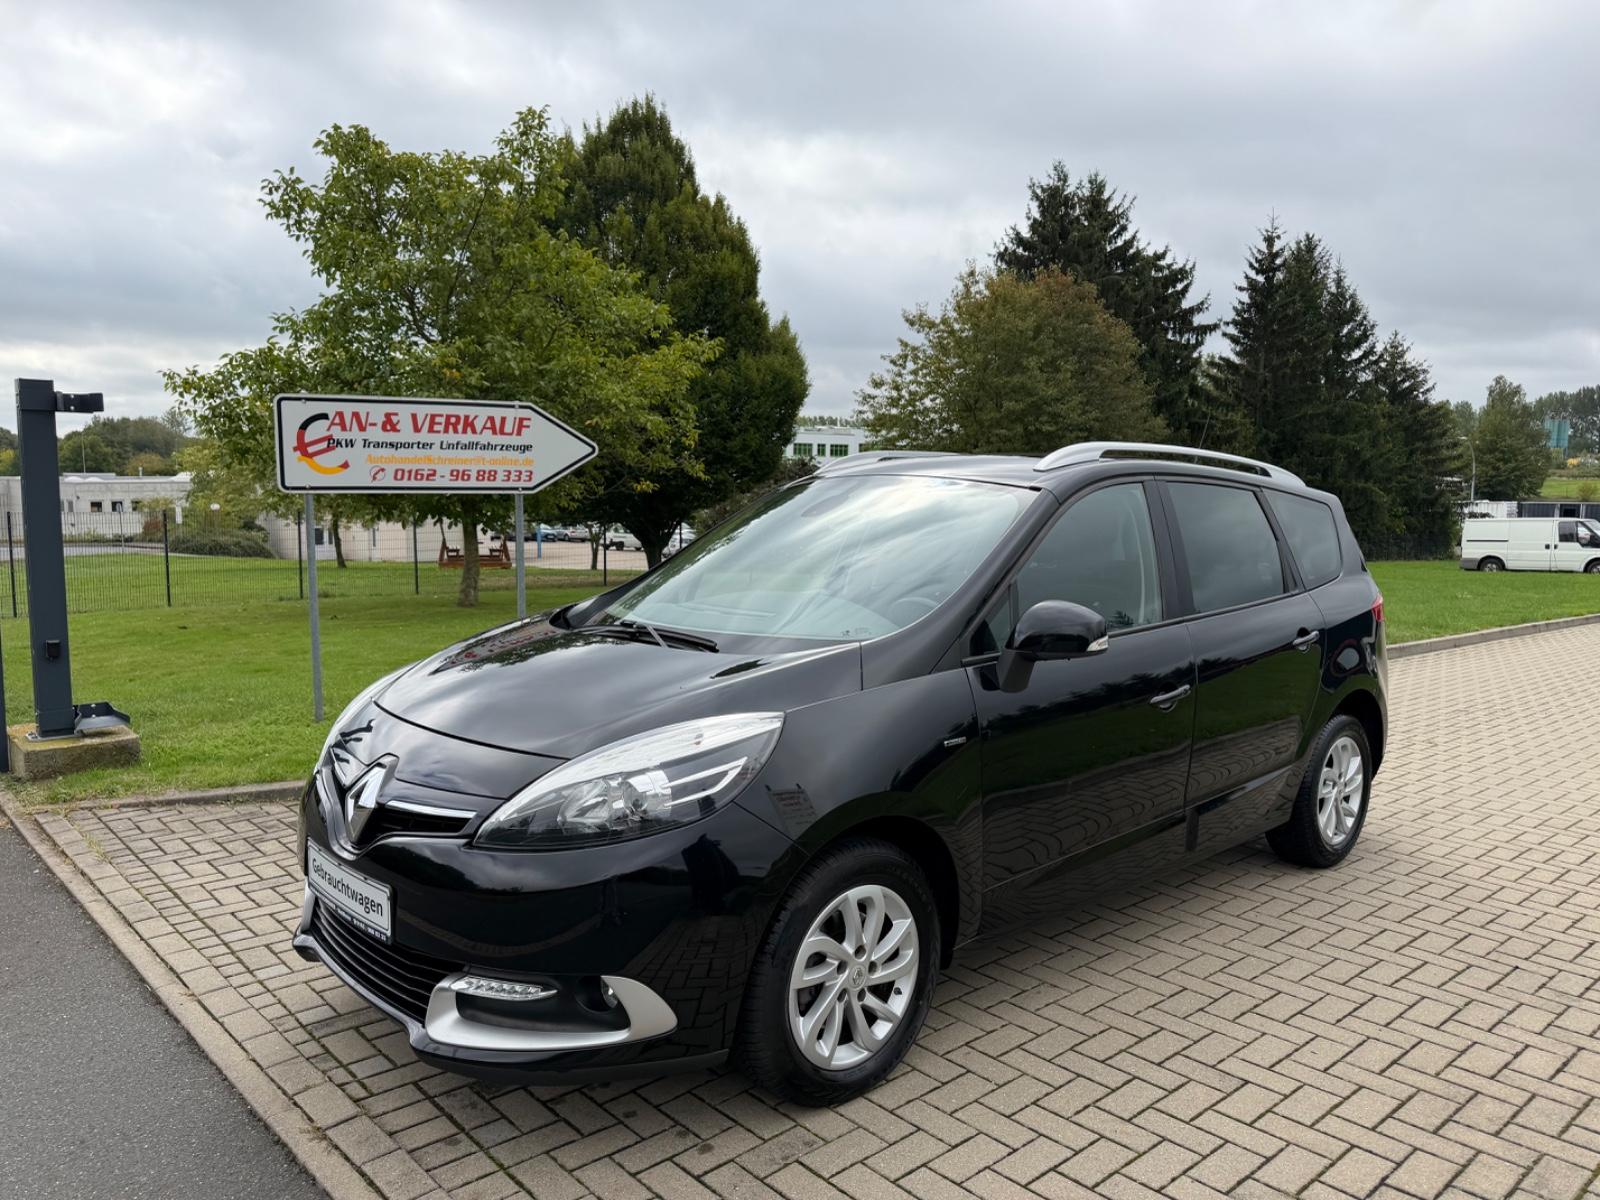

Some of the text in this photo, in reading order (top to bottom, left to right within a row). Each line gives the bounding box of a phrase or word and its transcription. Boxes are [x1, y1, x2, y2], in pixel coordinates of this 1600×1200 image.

[410, 412, 532, 436] VERKAUF
[326, 438, 533, 454] PKW Transporter Unfallfahrzeuge
[393, 468, 437, 481] 0162
[448, 469, 471, 482] 96
[475, 469, 498, 482] 88
[501, 469, 534, 482] 333
[312, 858, 383, 917] Gebrauchtwagen
